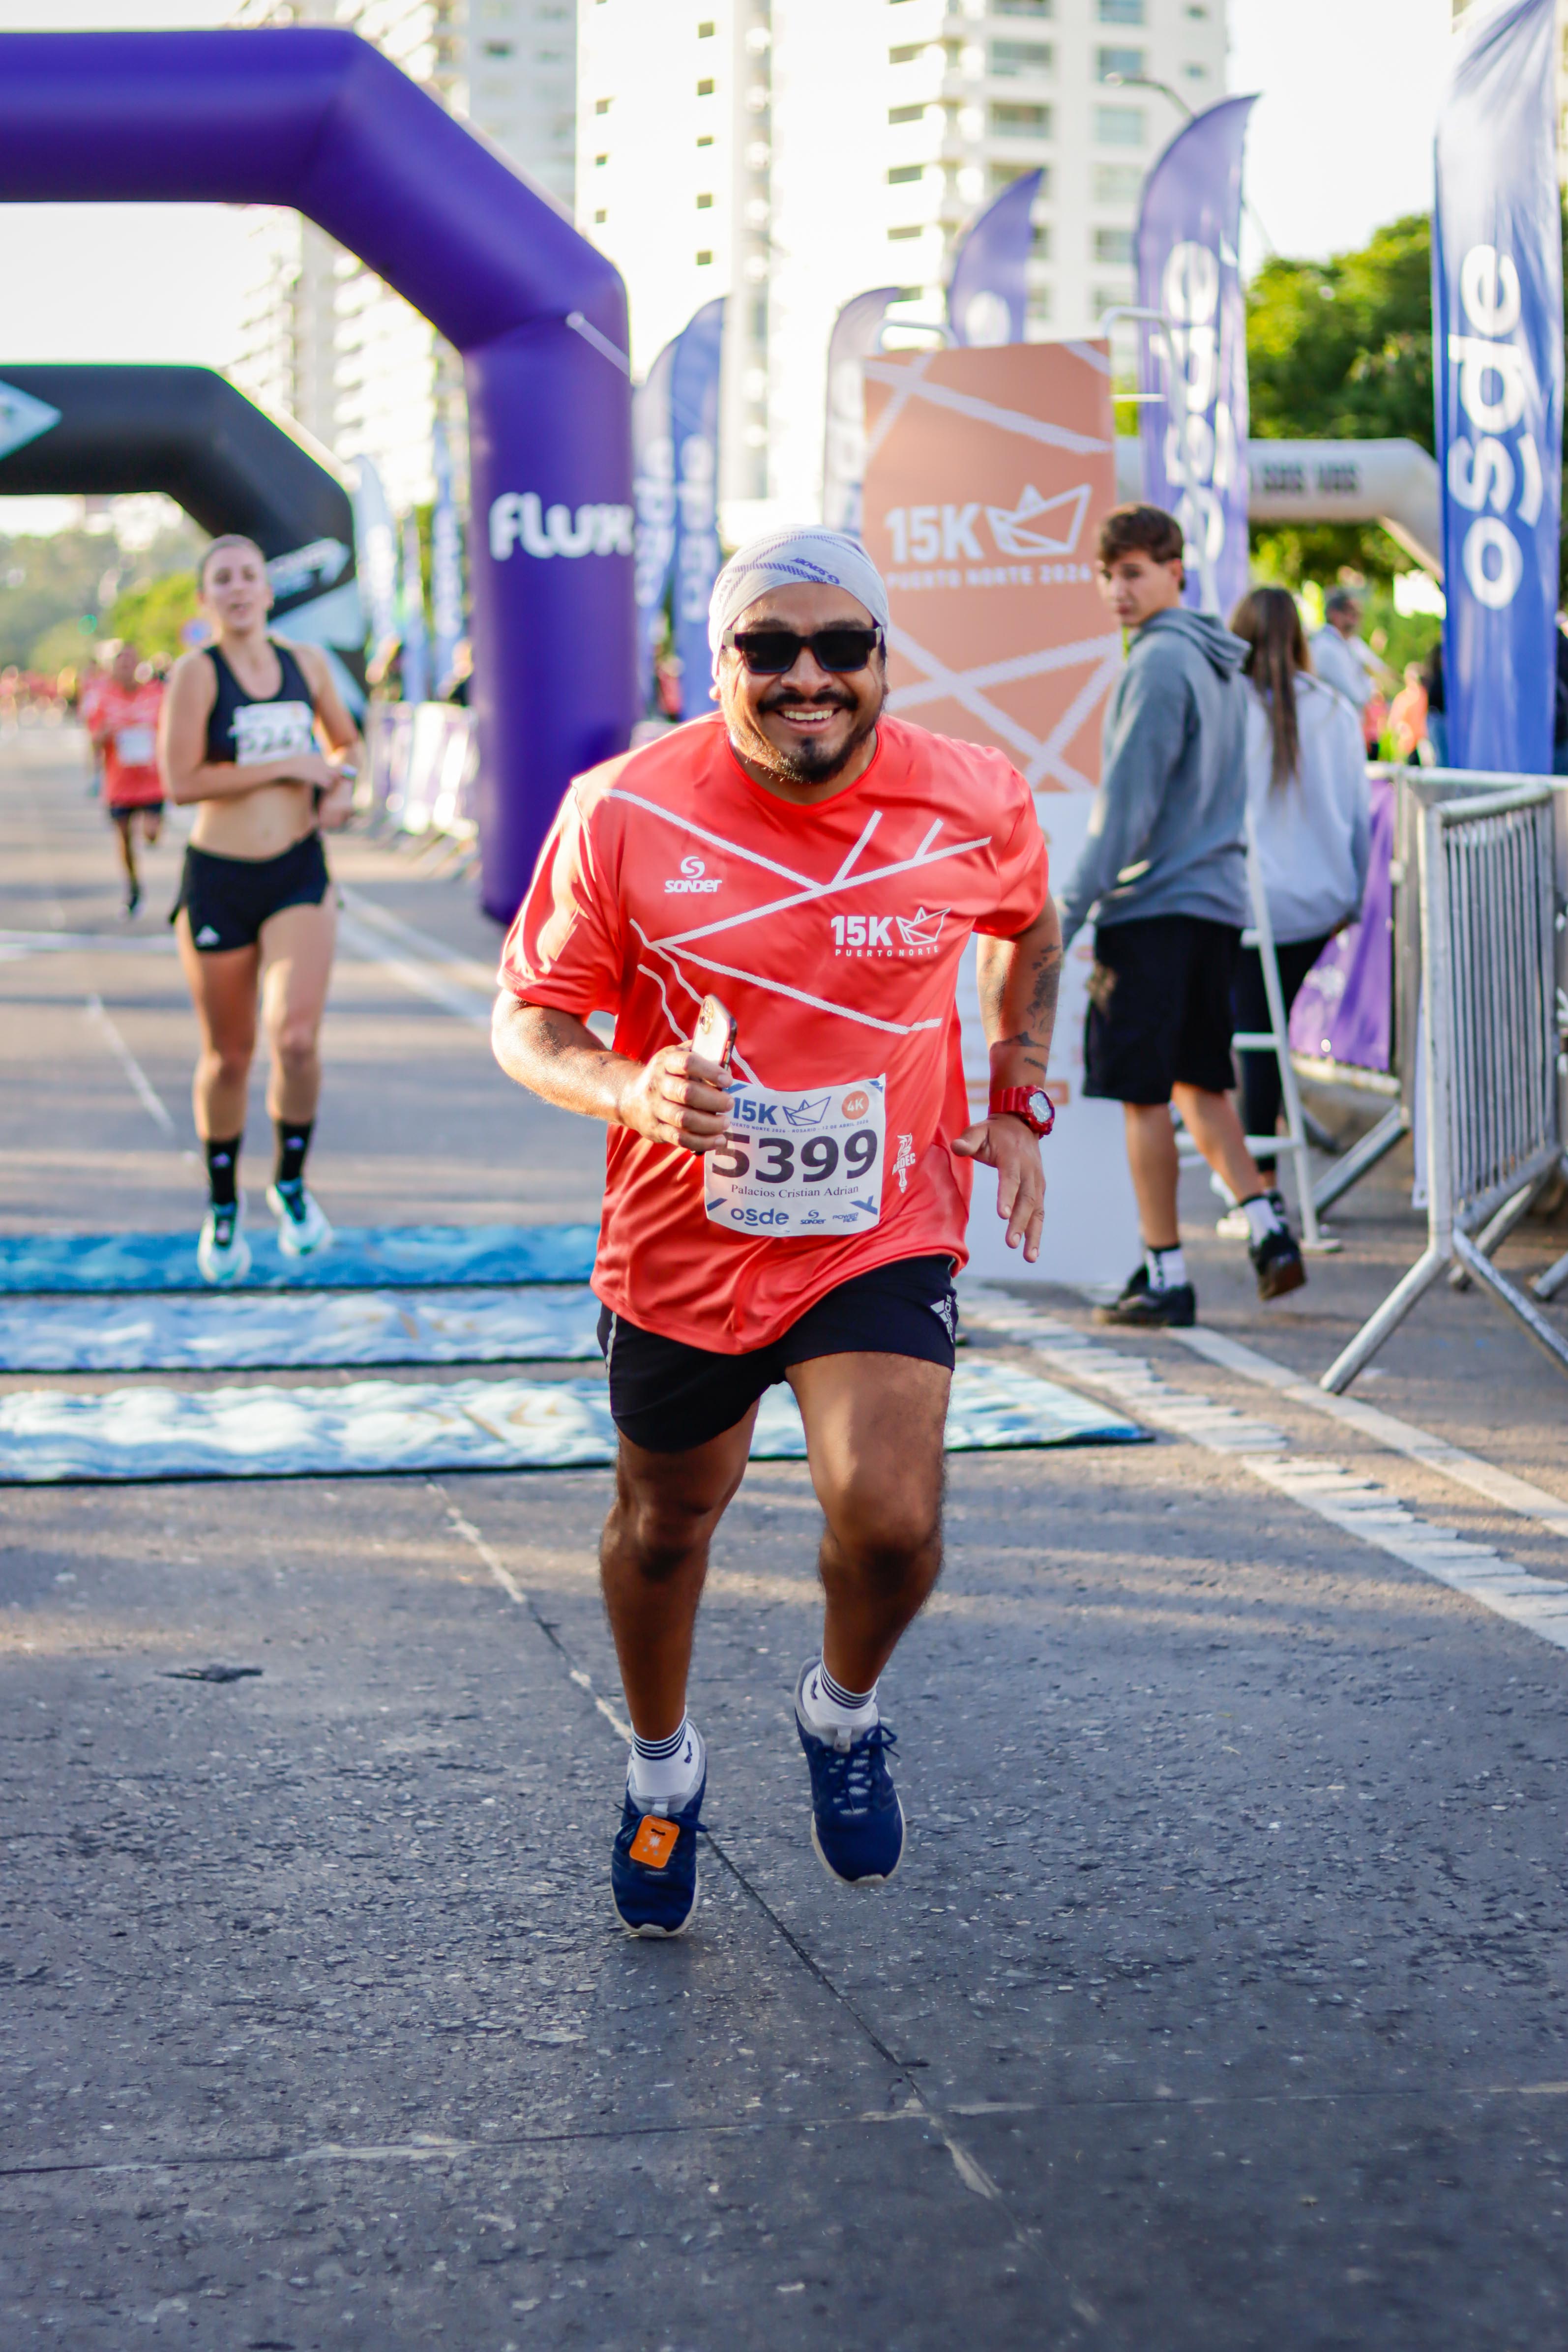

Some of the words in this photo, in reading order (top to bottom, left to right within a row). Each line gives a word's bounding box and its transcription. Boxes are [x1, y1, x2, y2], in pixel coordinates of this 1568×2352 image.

[1448, 244, 1543, 611] osde
[885, 501, 984, 564] 15K
[886, 569, 961, 590] PUERTO
[966, 565, 1033, 587] NORTE
[831, 915, 893, 946] 15K
[899, 945, 938, 956] NORTE
[733, 1097, 777, 1125] 15K
[847, 1098, 863, 1112] 4K
[712, 1129, 878, 1183] 5399
[731, 1184, 775, 1198] Palacios
[778, 1188, 820, 1198] Cristian
[824, 1184, 859, 1196] Adrian
[730, 1207, 789, 1226] osde
